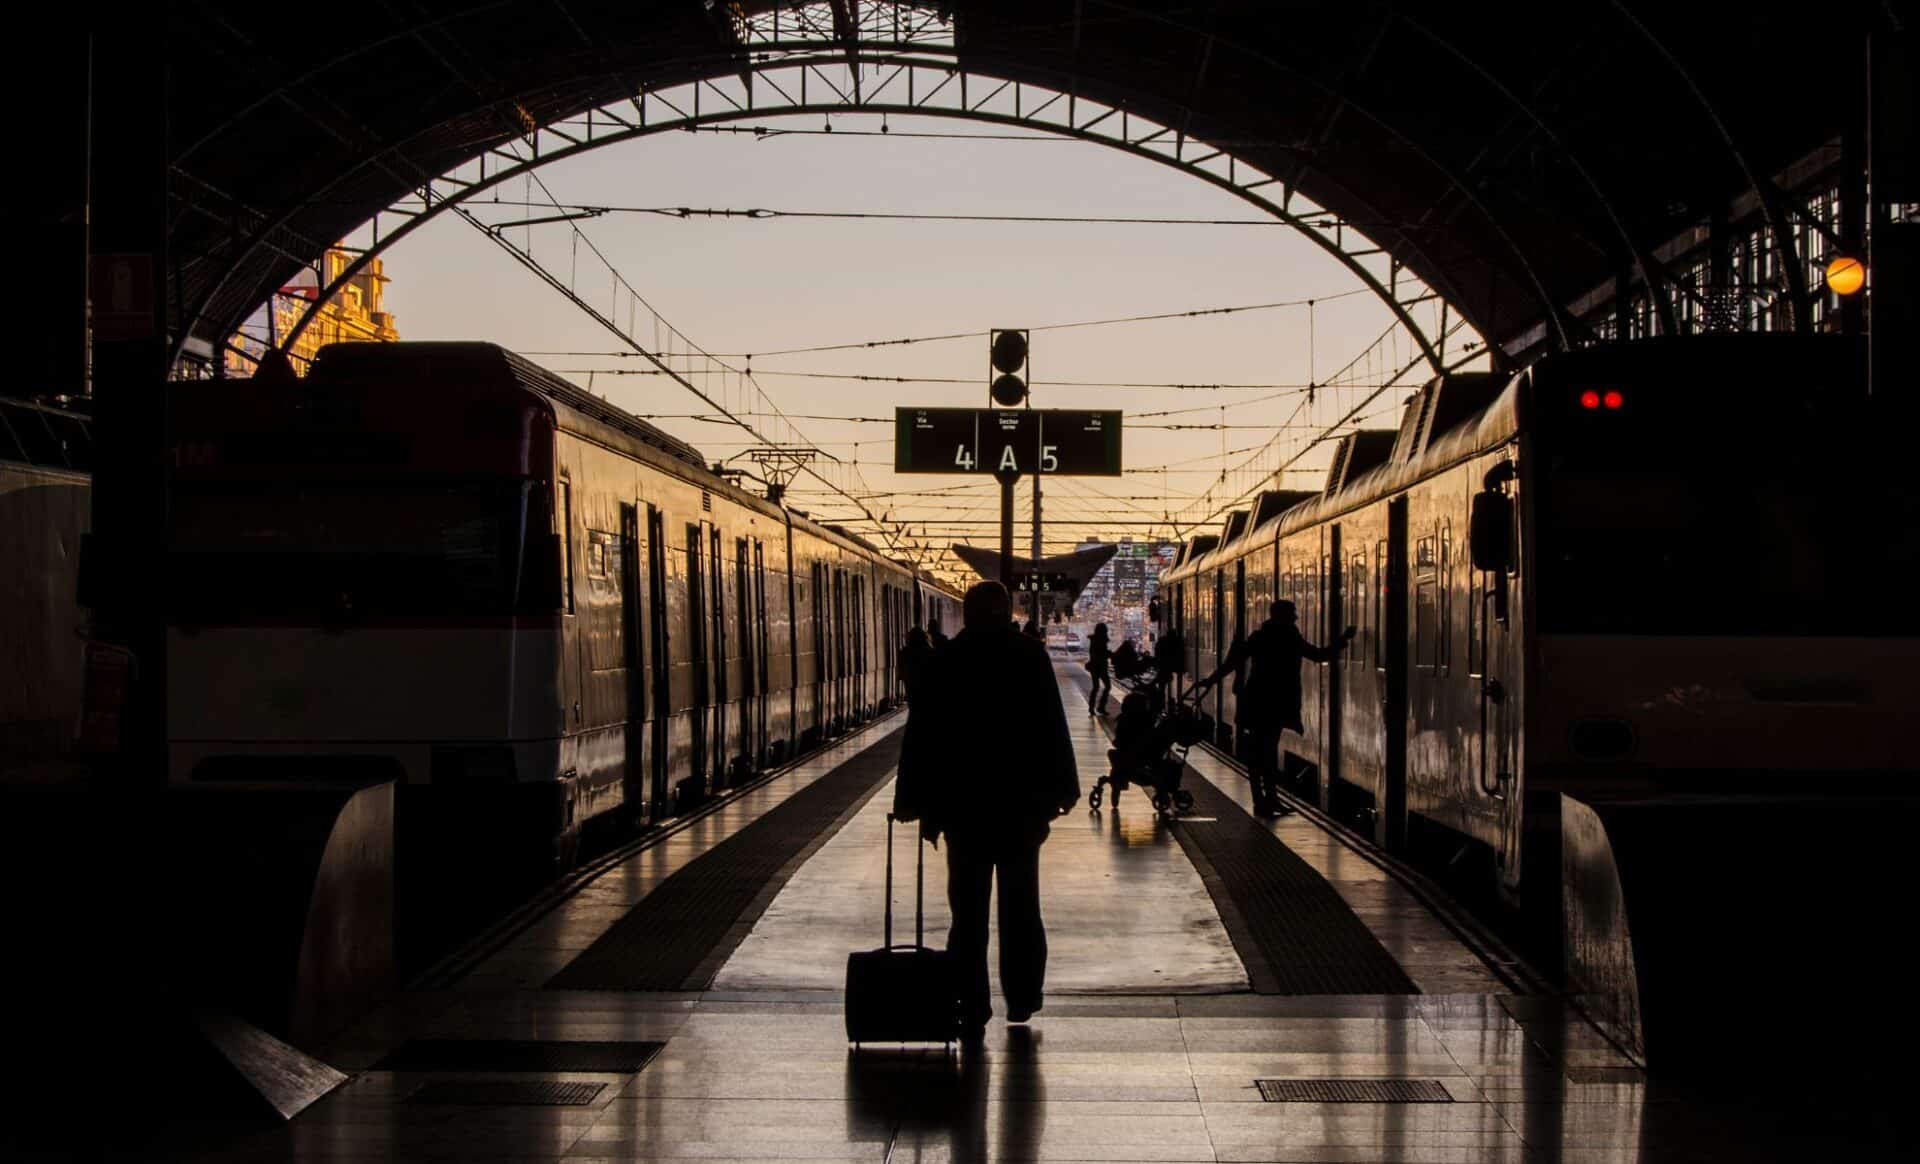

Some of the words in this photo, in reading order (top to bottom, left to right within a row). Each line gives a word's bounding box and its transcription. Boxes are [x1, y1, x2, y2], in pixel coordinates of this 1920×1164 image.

[954, 444, 974, 471] 4
[998, 444, 1018, 471] A
[1042, 445, 1059, 472] 5
[1042, 582, 1051, 592] 5
